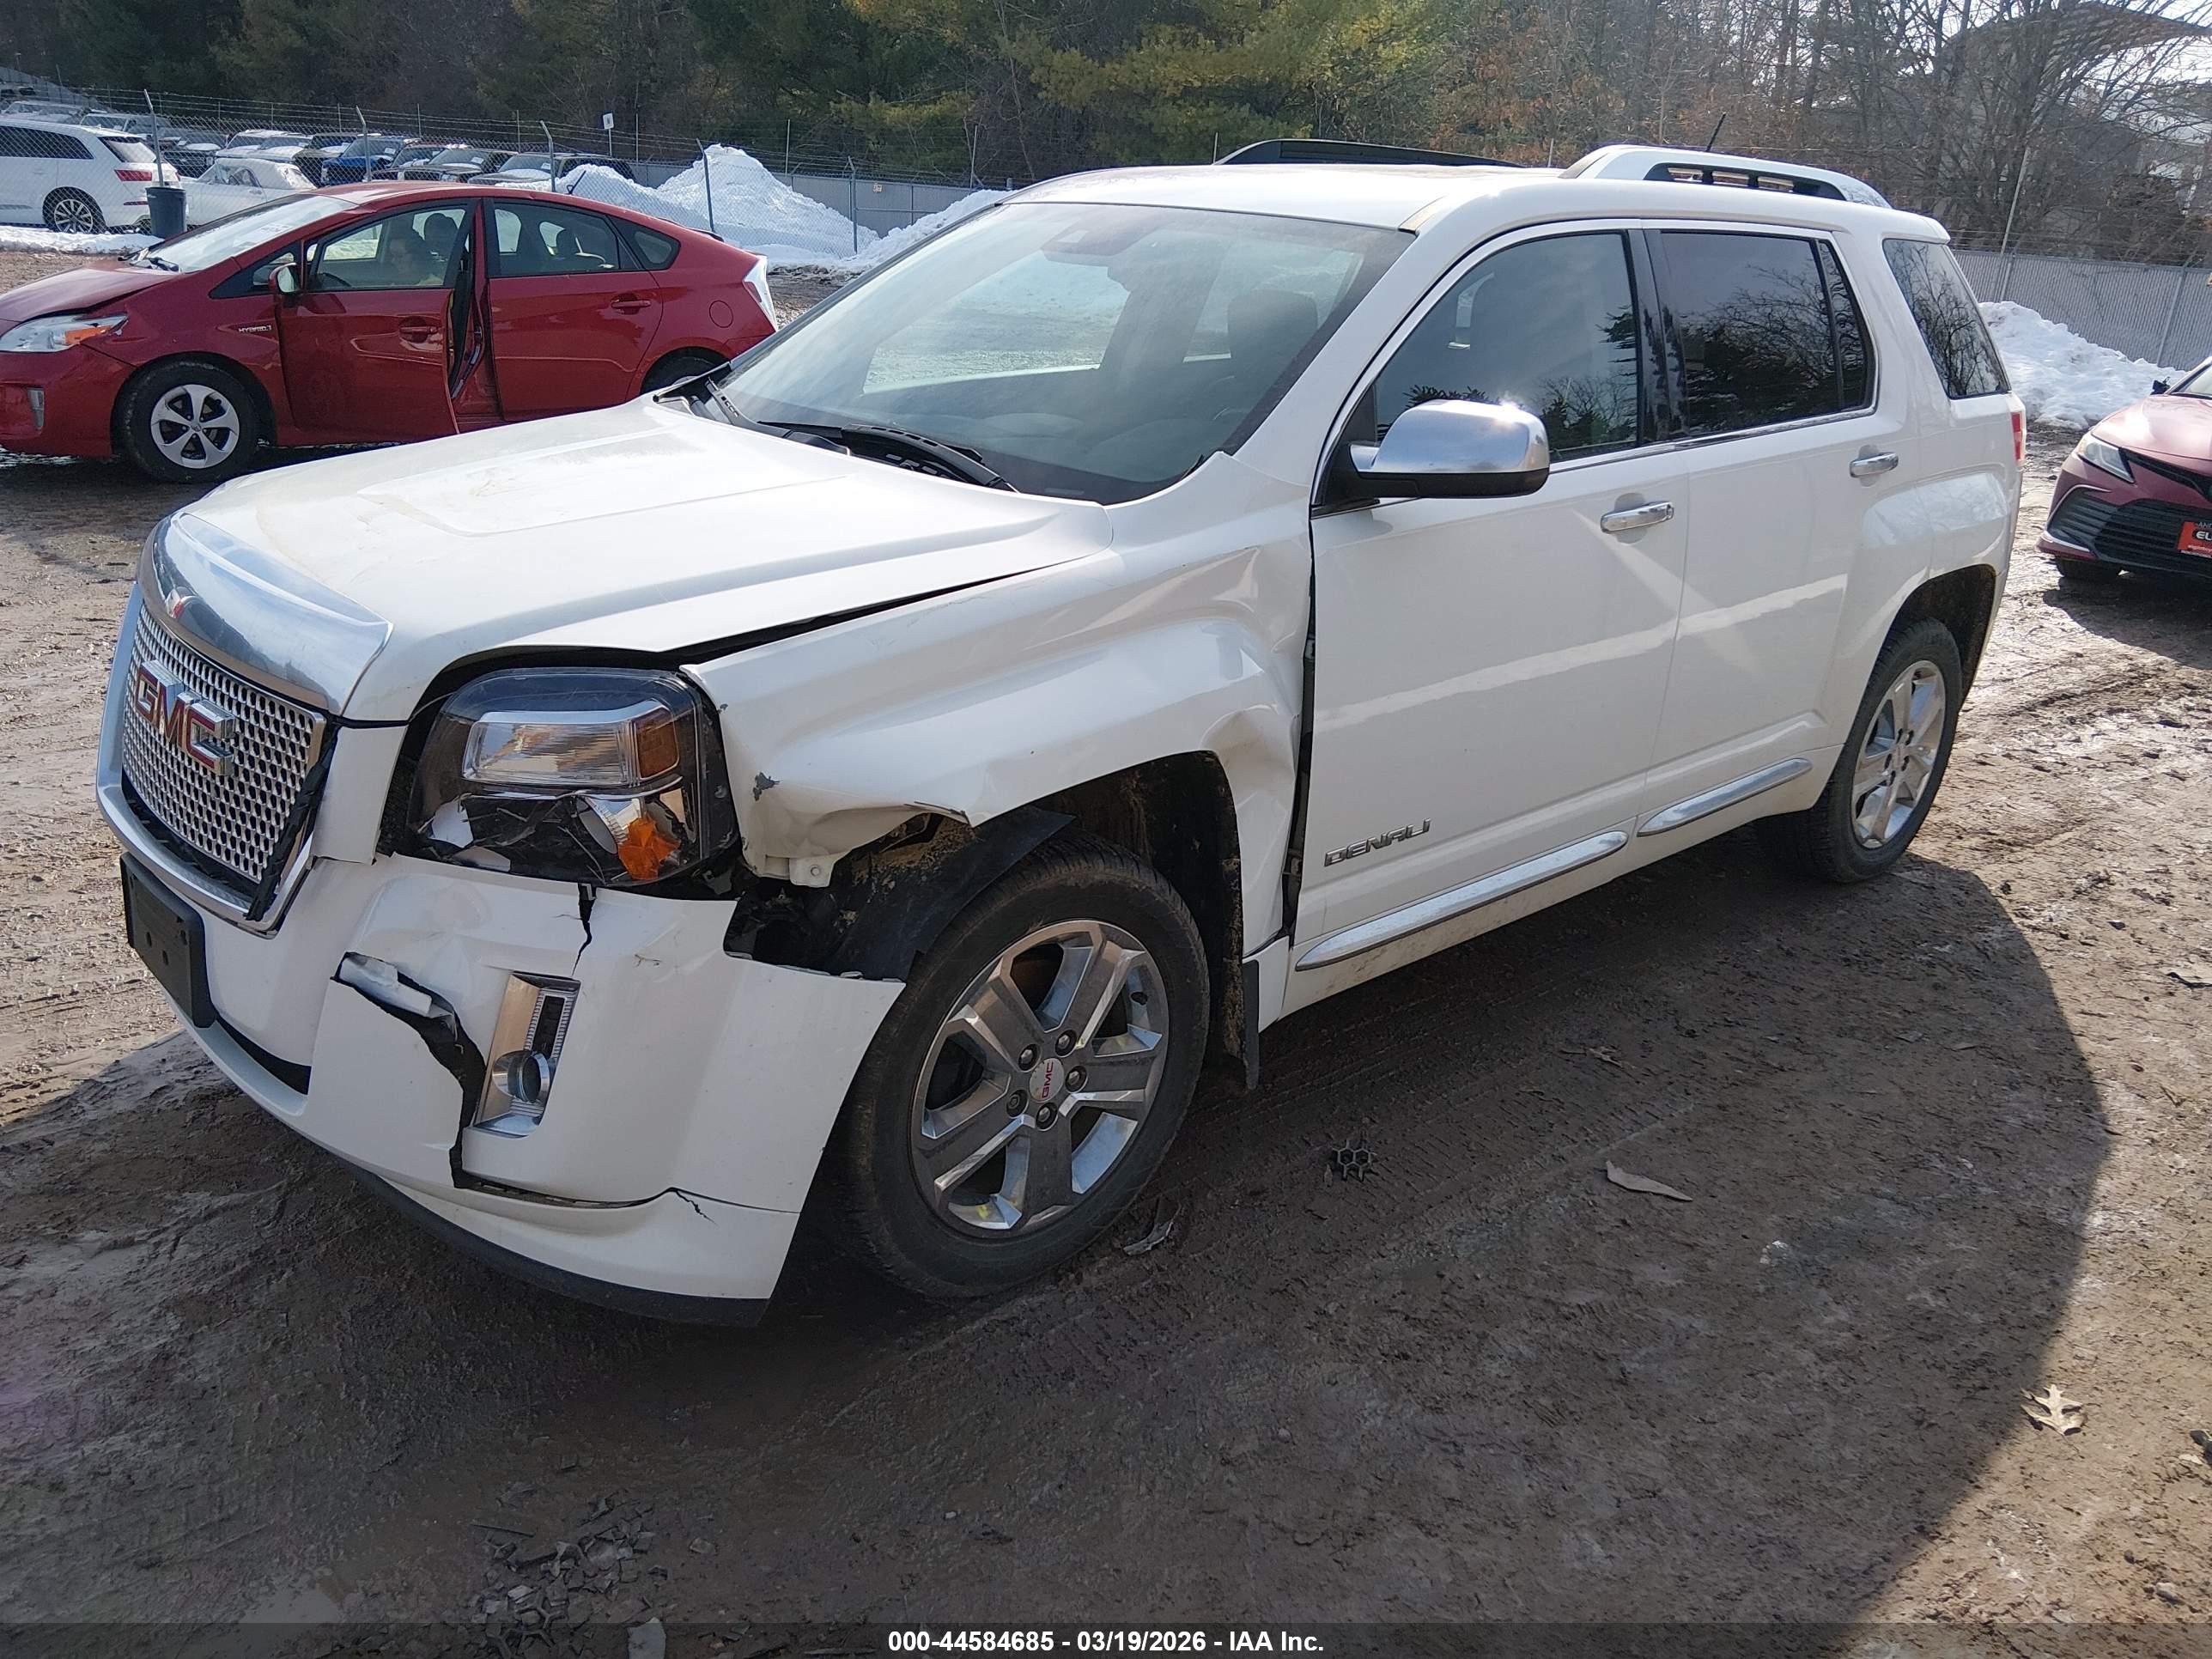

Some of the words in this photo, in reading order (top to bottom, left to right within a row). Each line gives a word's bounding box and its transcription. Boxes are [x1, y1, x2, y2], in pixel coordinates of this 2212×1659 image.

[136, 659, 234, 775] GMC
[1324, 818, 1431, 867] DENALI
[1042, 1061, 1054, 1098] GMC
